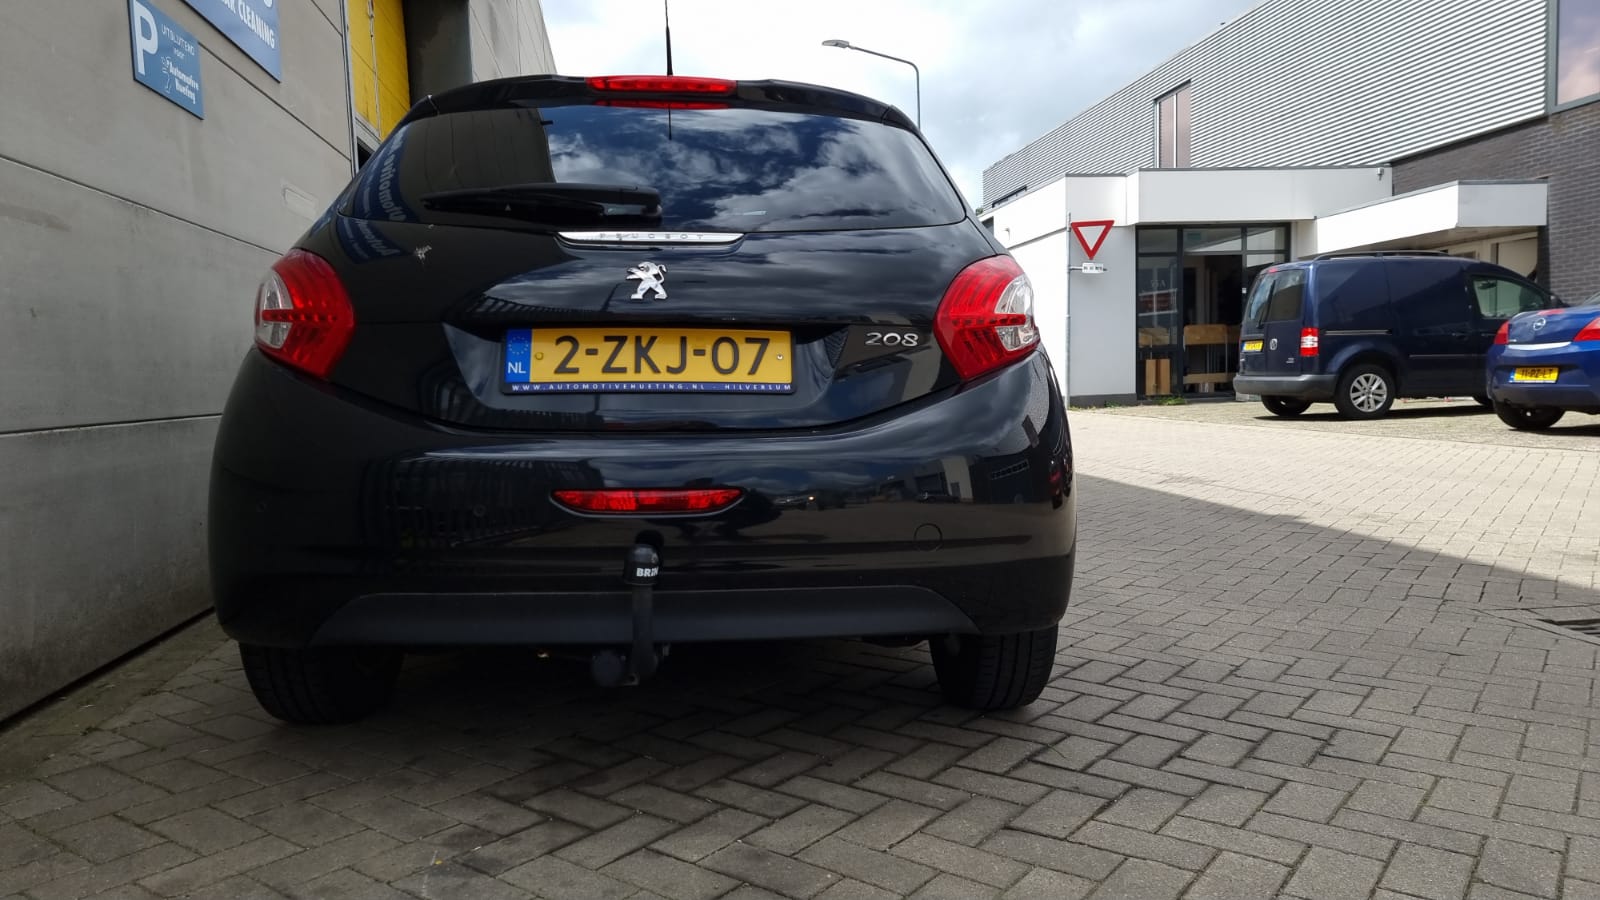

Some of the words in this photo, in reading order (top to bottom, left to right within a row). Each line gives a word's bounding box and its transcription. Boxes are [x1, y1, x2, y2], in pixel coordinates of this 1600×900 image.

[238, 0, 275, 50] CLEANING
[132, 0, 159, 76] P
[600, 231, 704, 240] PEUGEOT
[865, 332, 919, 347] 208
[553, 334, 771, 376] 2-ZKJ-07
[507, 361, 527, 374] NL
[724, 383, 792, 391] HILVERSUM
[636, 566, 659, 577] BRIN
